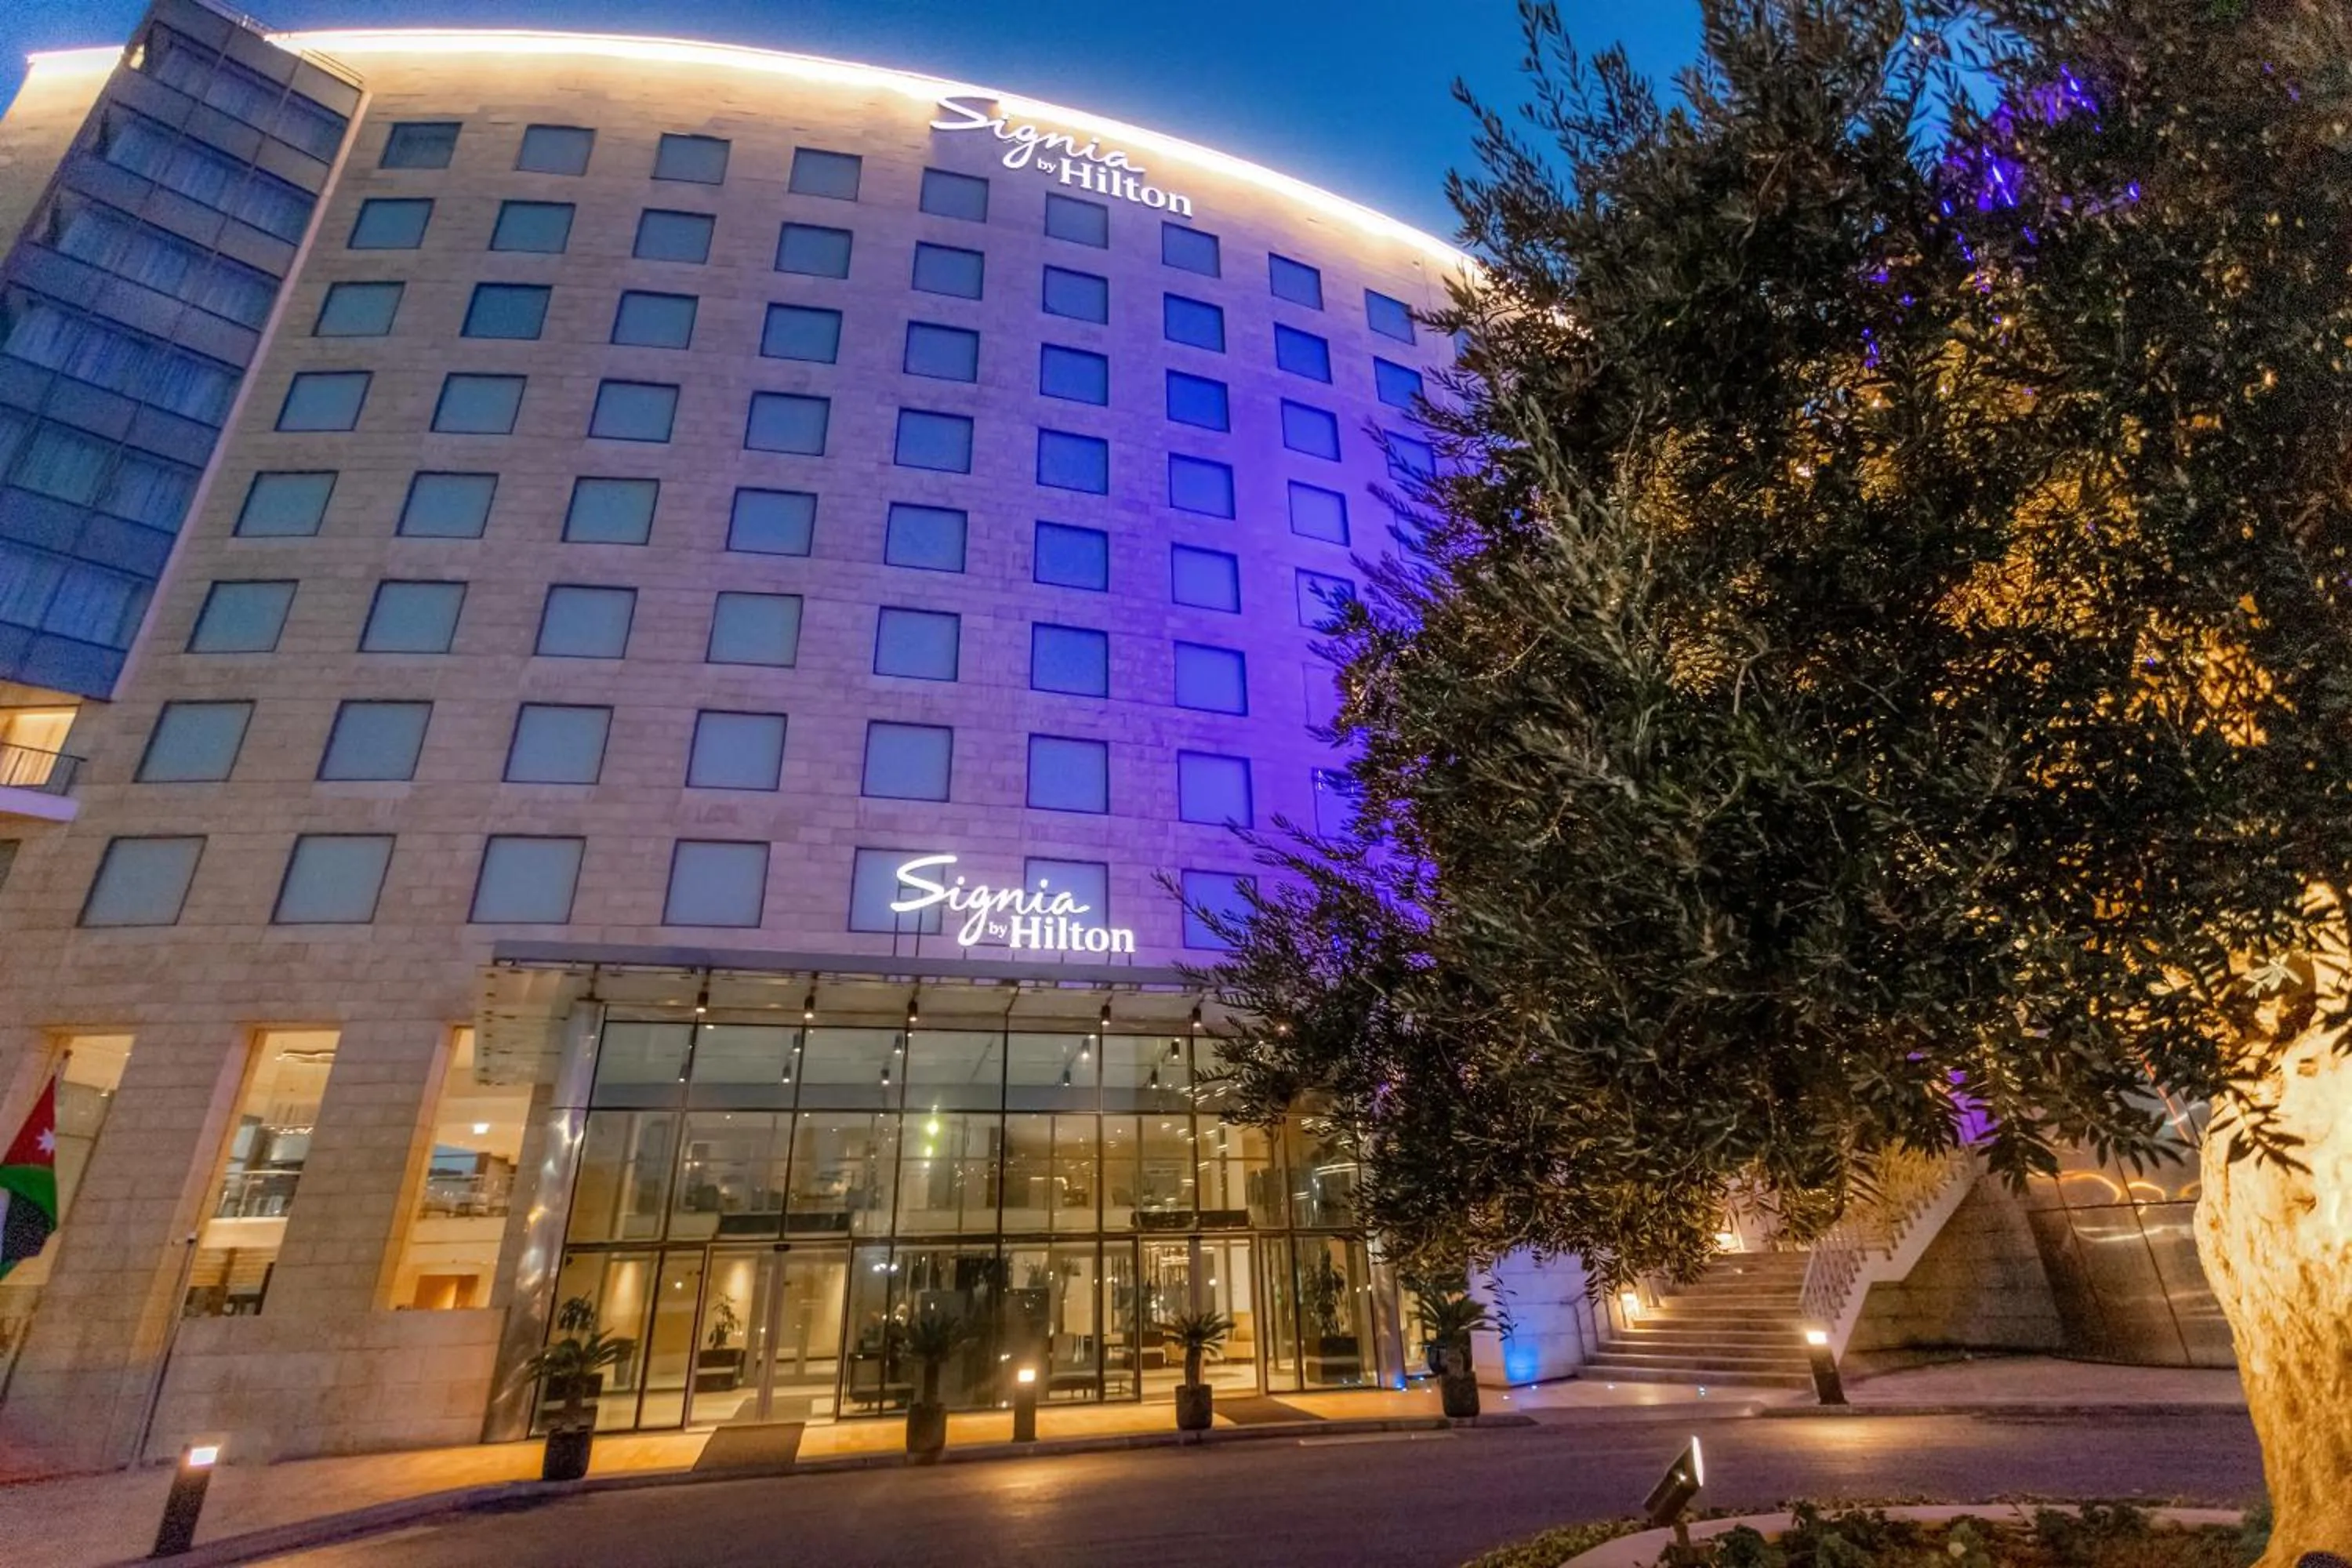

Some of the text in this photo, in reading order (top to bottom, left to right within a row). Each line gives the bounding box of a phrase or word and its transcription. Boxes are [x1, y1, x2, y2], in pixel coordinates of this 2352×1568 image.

[929, 95, 1145, 172] Signia
[1036, 157, 1193, 219] by Hilton
[891, 855, 1090, 946] Signia
[989, 915, 1136, 953] by Hilton
